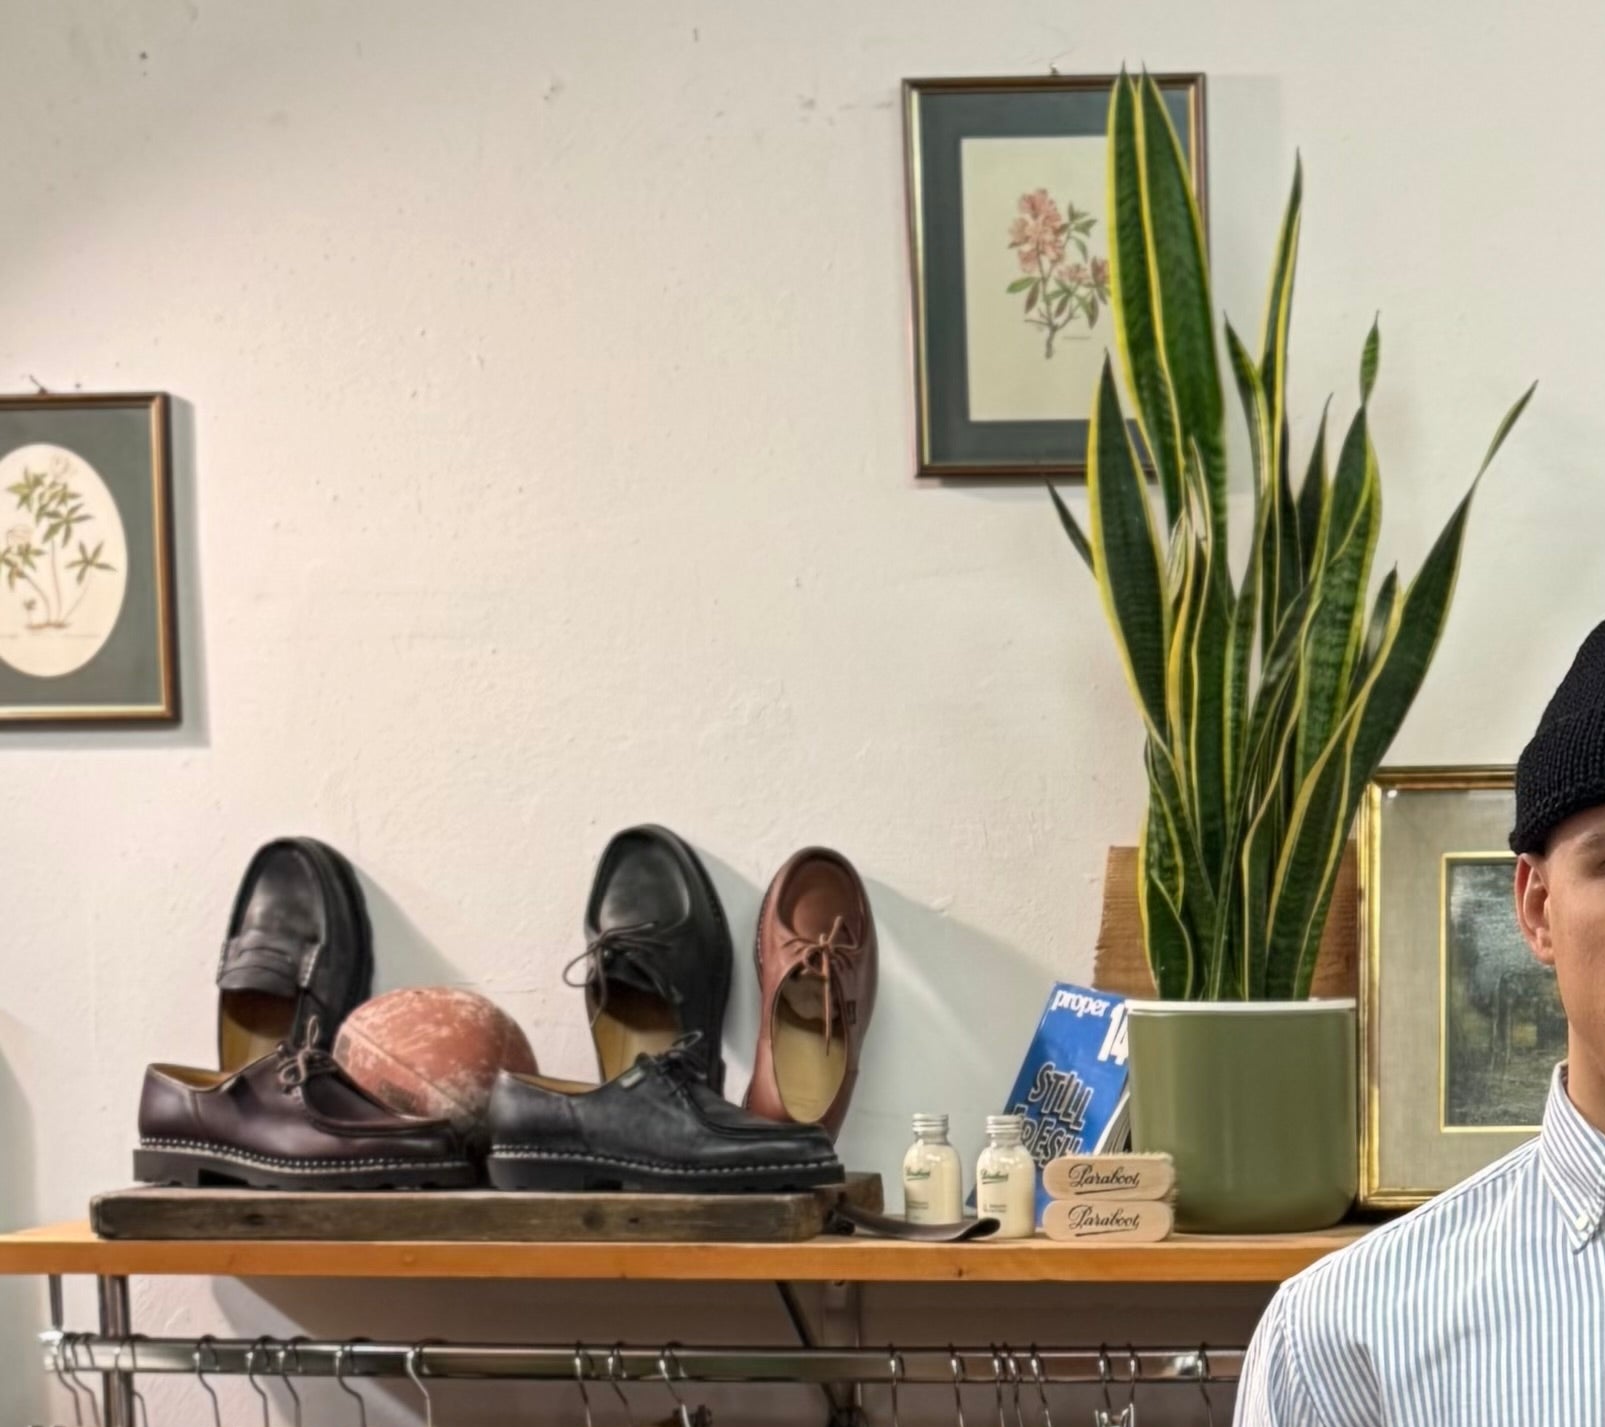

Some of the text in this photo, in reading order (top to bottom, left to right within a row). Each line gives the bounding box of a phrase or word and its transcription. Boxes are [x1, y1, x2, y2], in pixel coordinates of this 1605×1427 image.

[1051, 989, 1111, 1018] proper
[1028, 1060, 1094, 1131] STILL
[1013, 1104, 1083, 1168] RES
[1067, 1163, 1140, 1191] Paraboot
[1067, 1204, 1140, 1232] Paraboot
